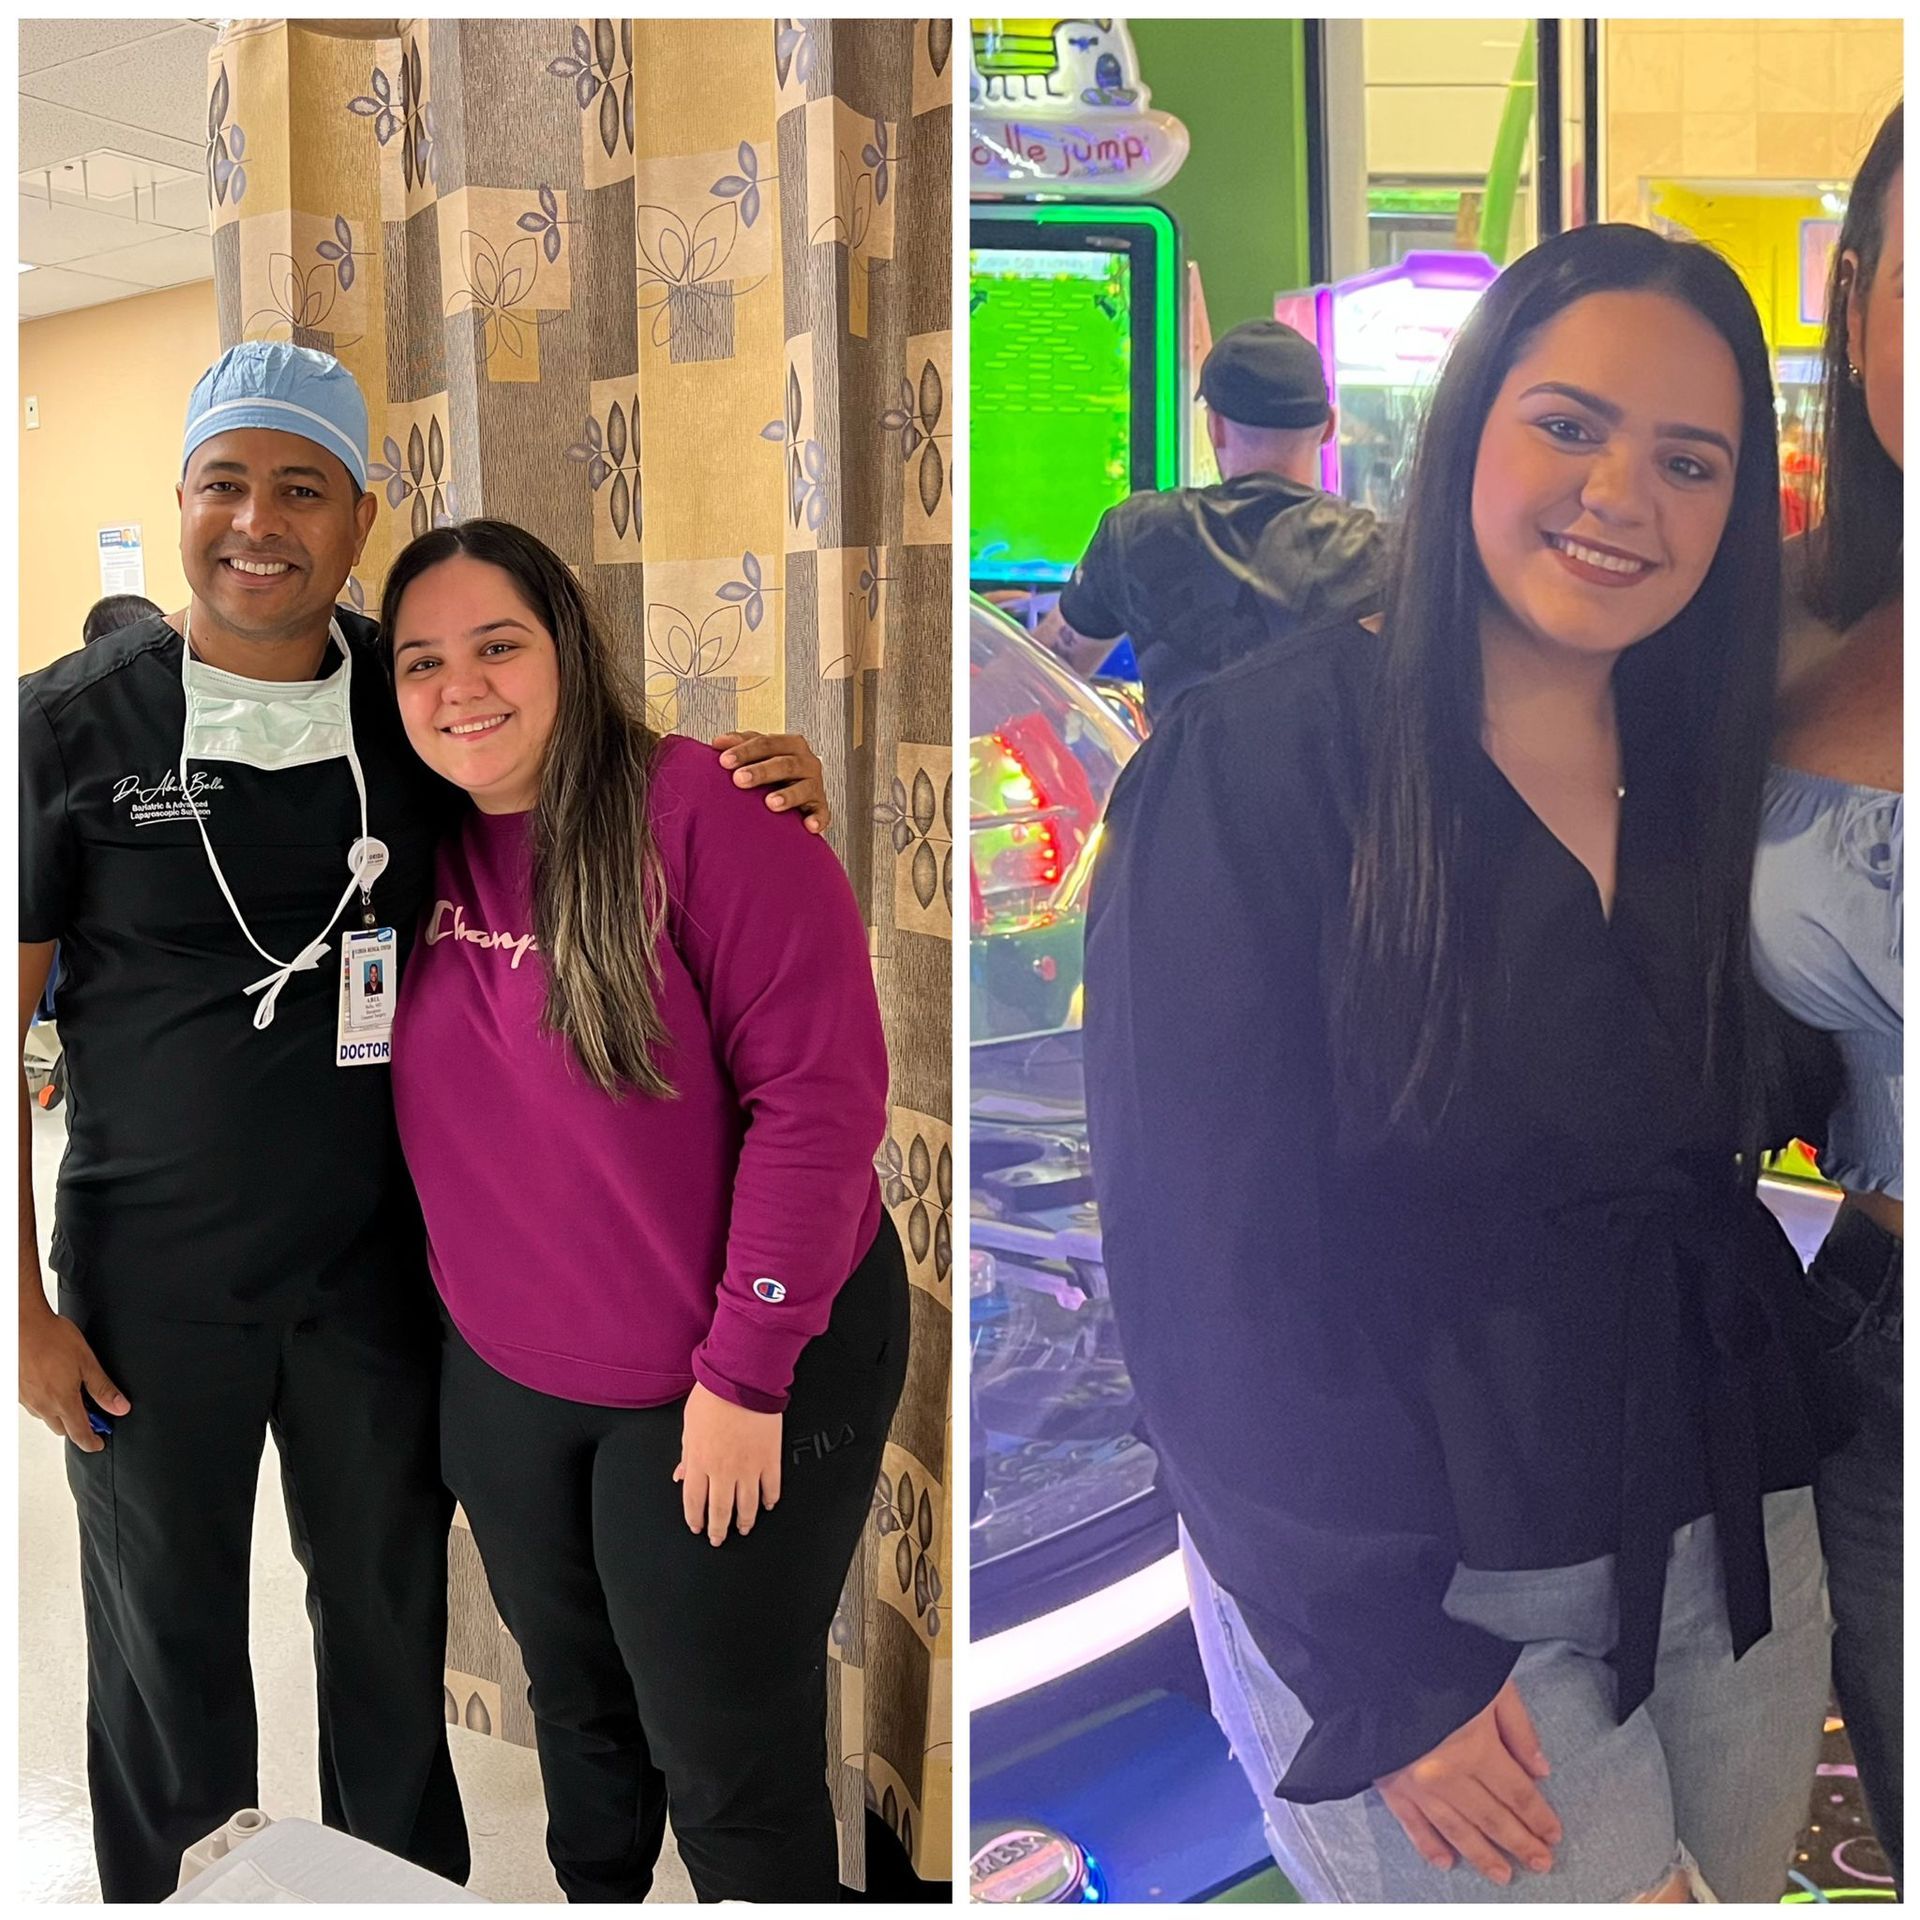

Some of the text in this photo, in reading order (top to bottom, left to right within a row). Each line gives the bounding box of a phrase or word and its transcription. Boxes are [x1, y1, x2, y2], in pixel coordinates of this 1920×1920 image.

[1058, 135, 1143, 176] jump
[182, 771, 224, 800] Bello
[130, 807, 211, 820] Laparoscopic Sureon
[132, 800, 208, 812] Bariatric & Advaced
[340, 1042, 389, 1060] DOCTOR
[792, 1423, 855, 1464] FILA
